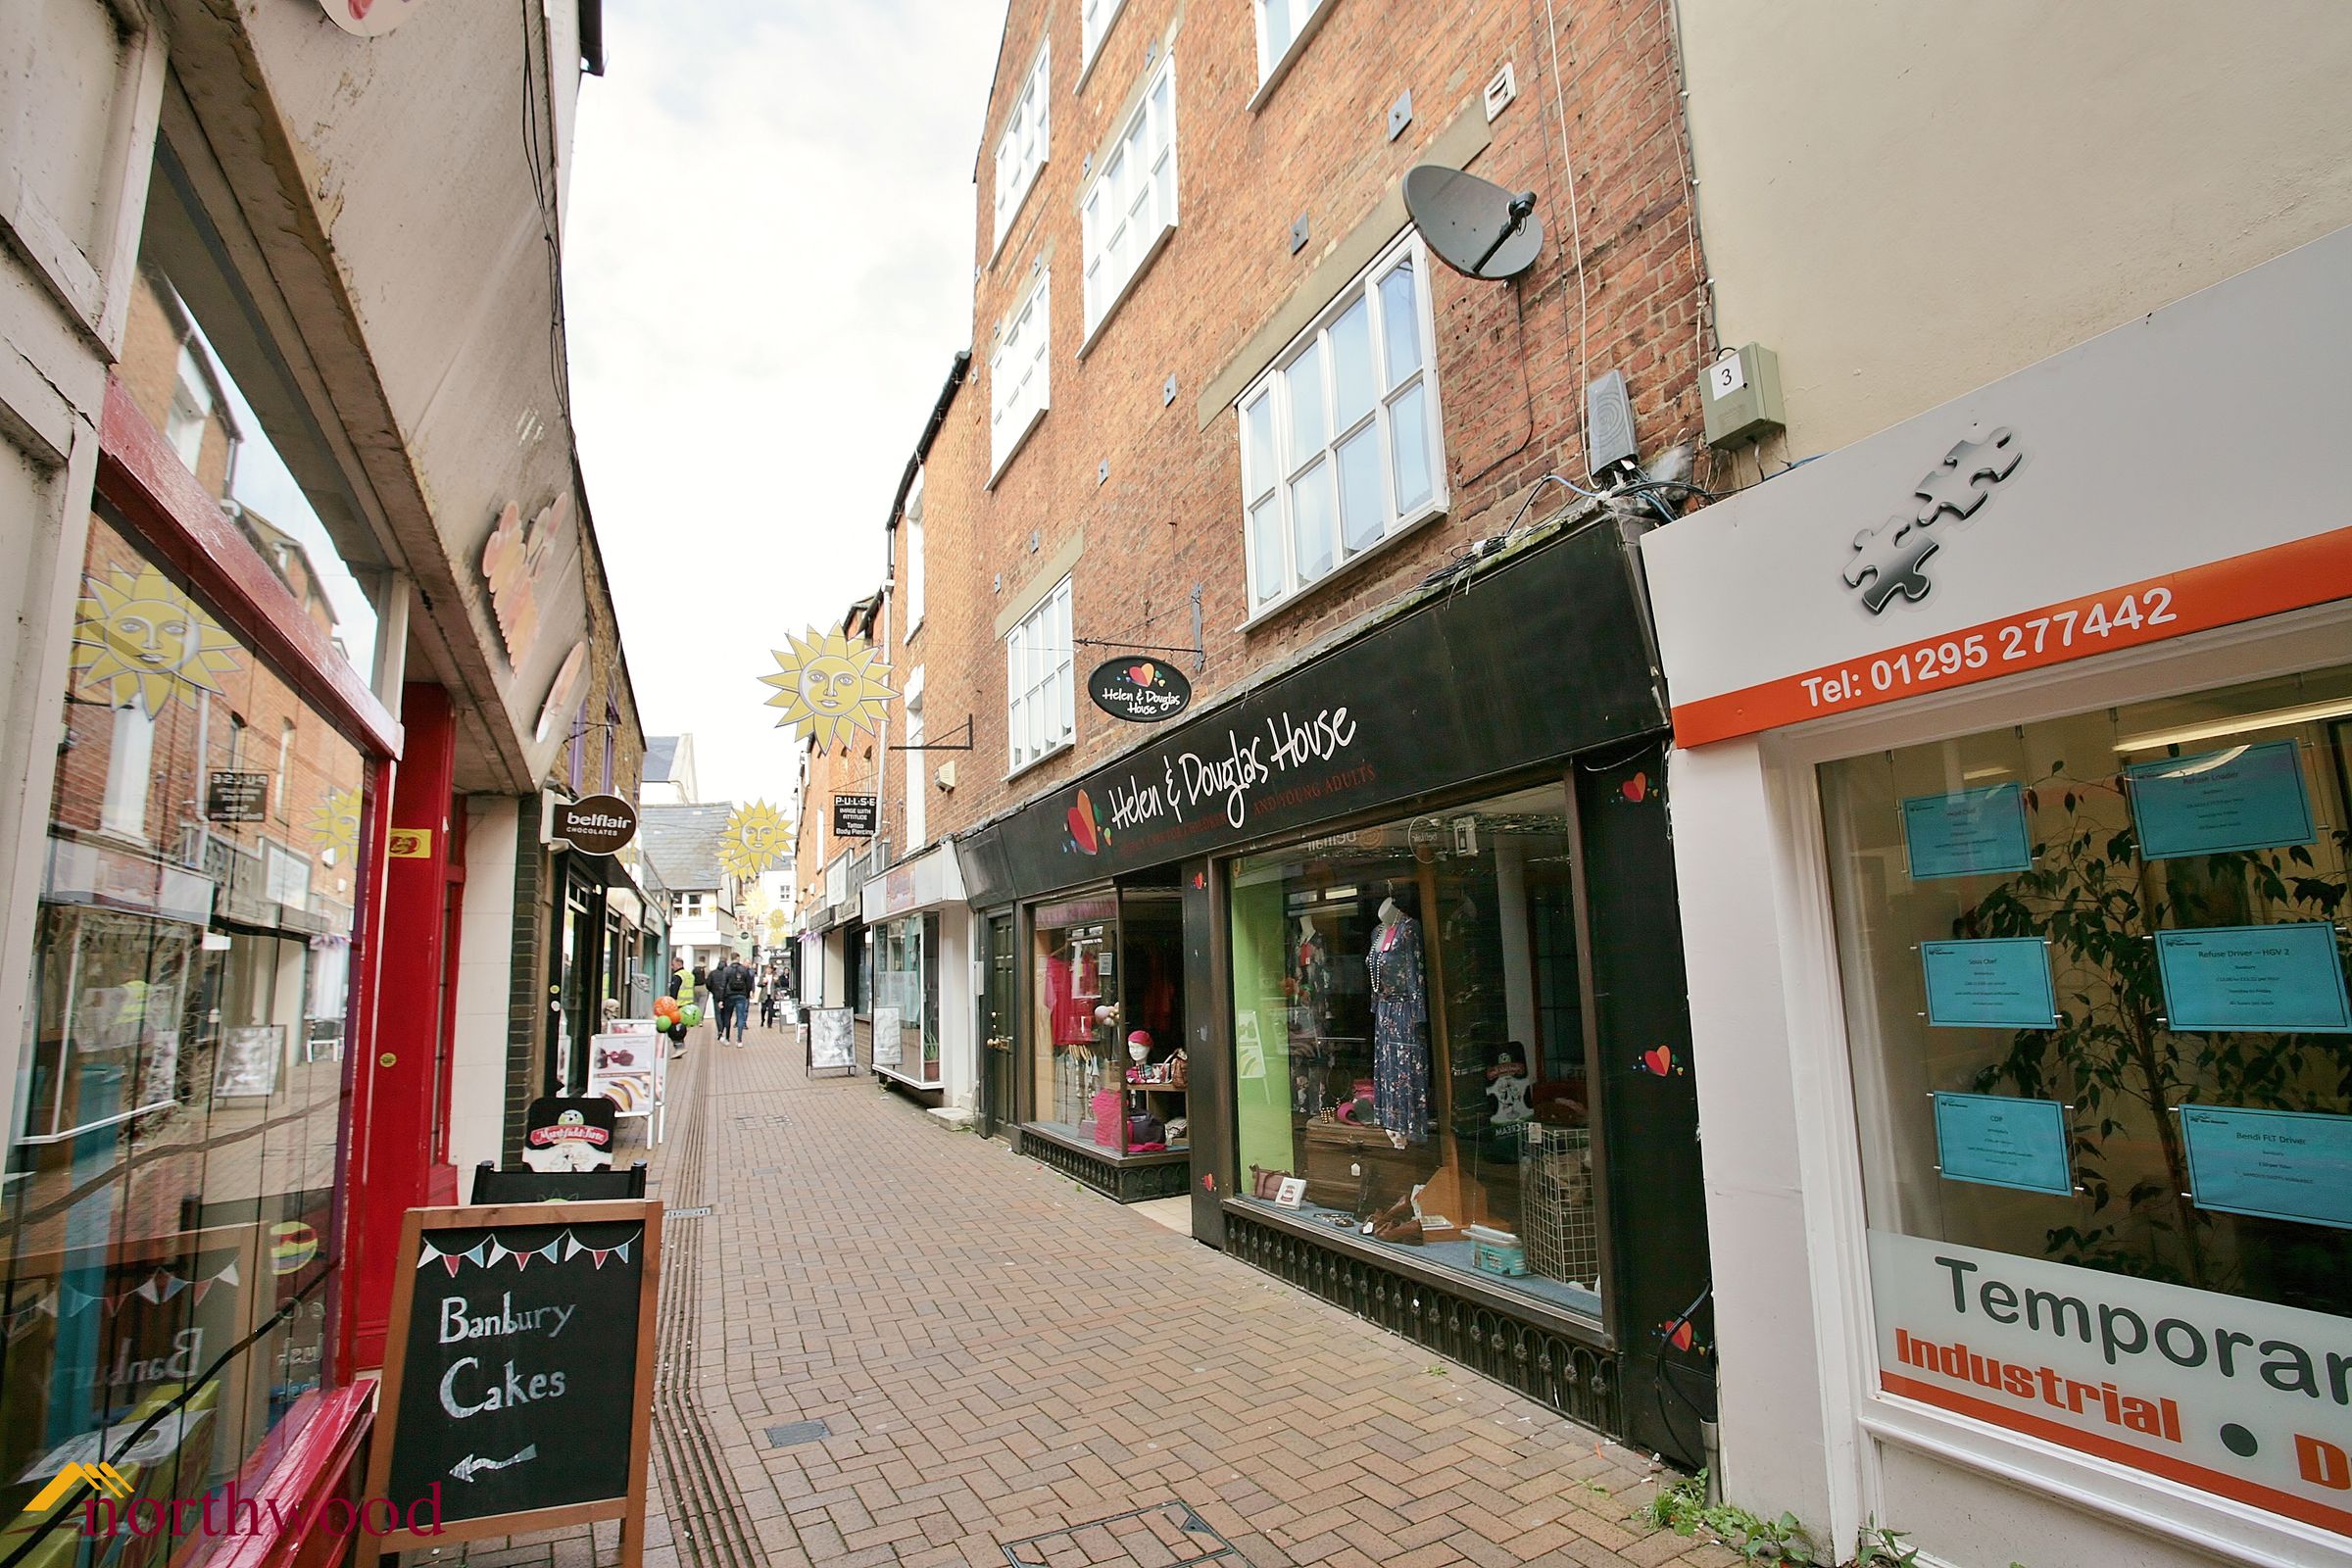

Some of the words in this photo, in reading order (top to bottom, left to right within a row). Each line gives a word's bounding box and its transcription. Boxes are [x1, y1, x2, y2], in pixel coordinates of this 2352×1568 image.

[1721, 368, 1733, 386] 3
[1800, 669, 1862, 707] Tel:
[1870, 634, 1988, 691] 01295
[1999, 587, 2177, 660] 277442
[1102, 688, 1134, 701] Helen
[1136, 689, 1144, 705] &
[1146, 691, 1180, 710] Douglas
[1127, 702, 1157, 715] House
[1108, 775, 1164, 830] Helen
[1163, 755, 1183, 823] &
[1178, 730, 1269, 829] Douglas
[1267, 707, 1357, 771] House
[567, 812, 632, 829] belflair
[566, 827, 618, 836] CHOCOLATES
[2198, 950, 2226, 958] Refuse
[2228, 949, 2253, 957] Driver
[2236, 1132, 2261, 1141] Bendi
[2278, 1136, 2306, 1146] Driver
[439, 1291, 577, 1344] Banbury
[440, 1356, 566, 1419] Cakes
[1895, 1327, 2182, 1444] Industrial
